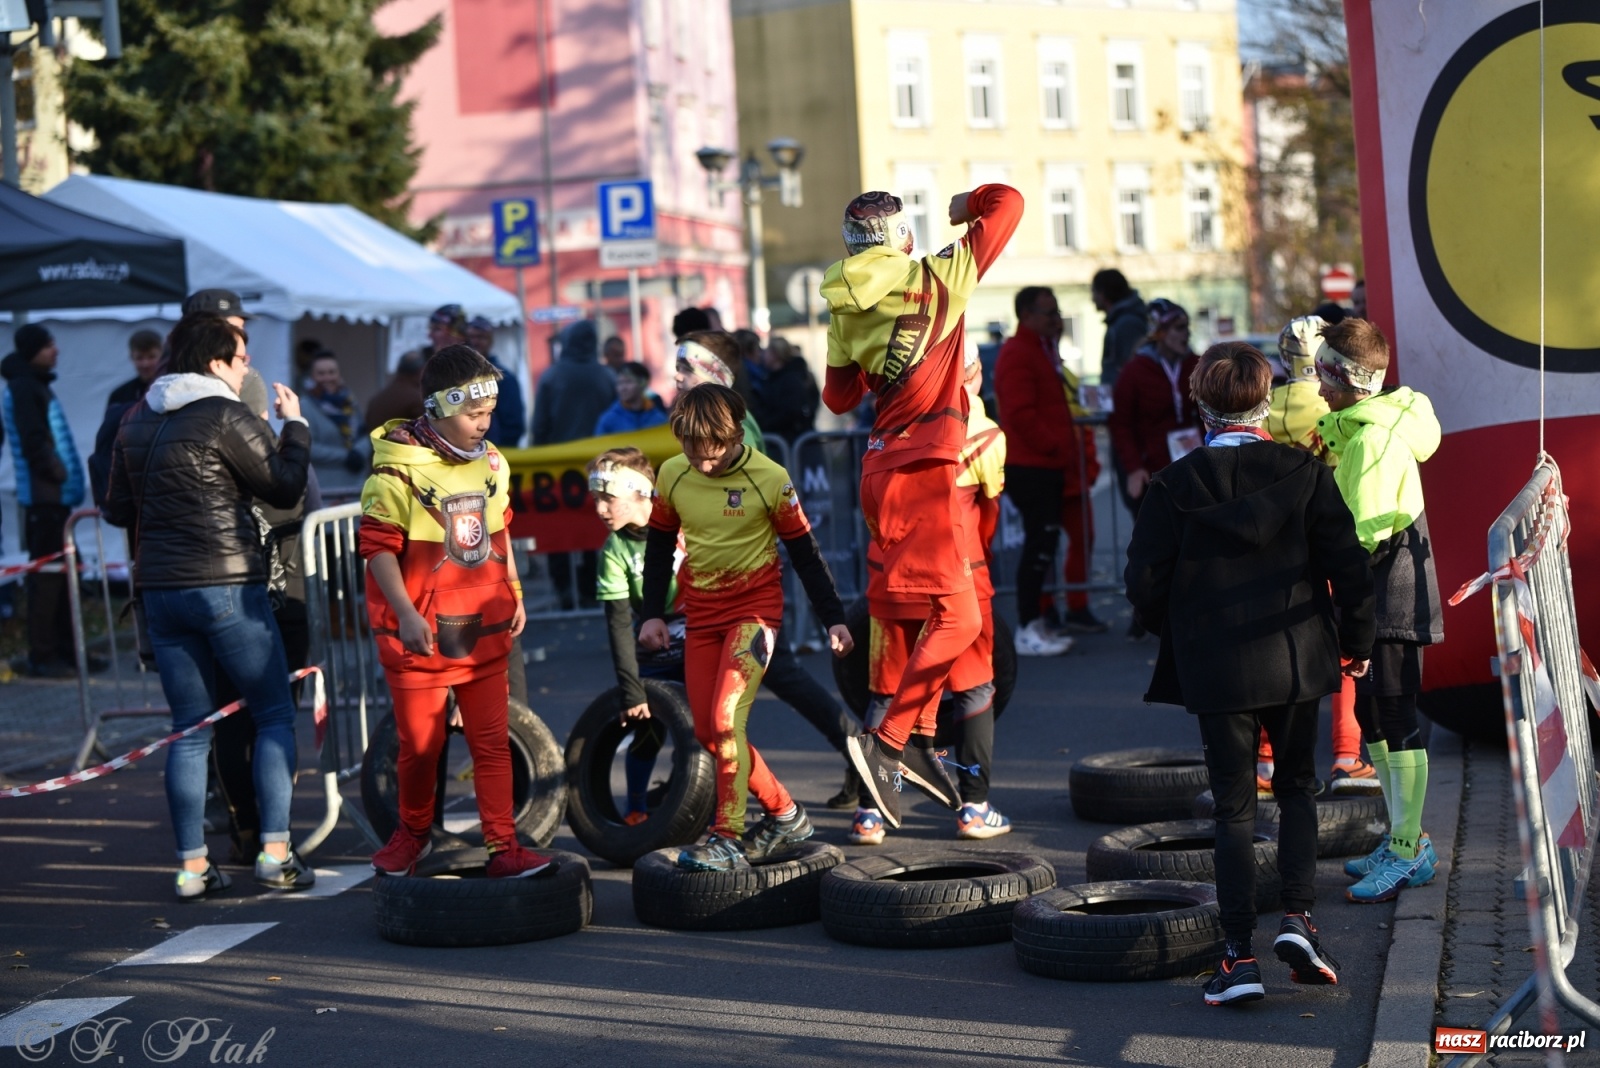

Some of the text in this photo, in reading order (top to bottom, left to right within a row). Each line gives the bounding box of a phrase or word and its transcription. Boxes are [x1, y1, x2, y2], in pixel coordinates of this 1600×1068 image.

[502, 201, 529, 233] P
[607, 185, 646, 236] P
[463, 549, 480, 562] OCR
